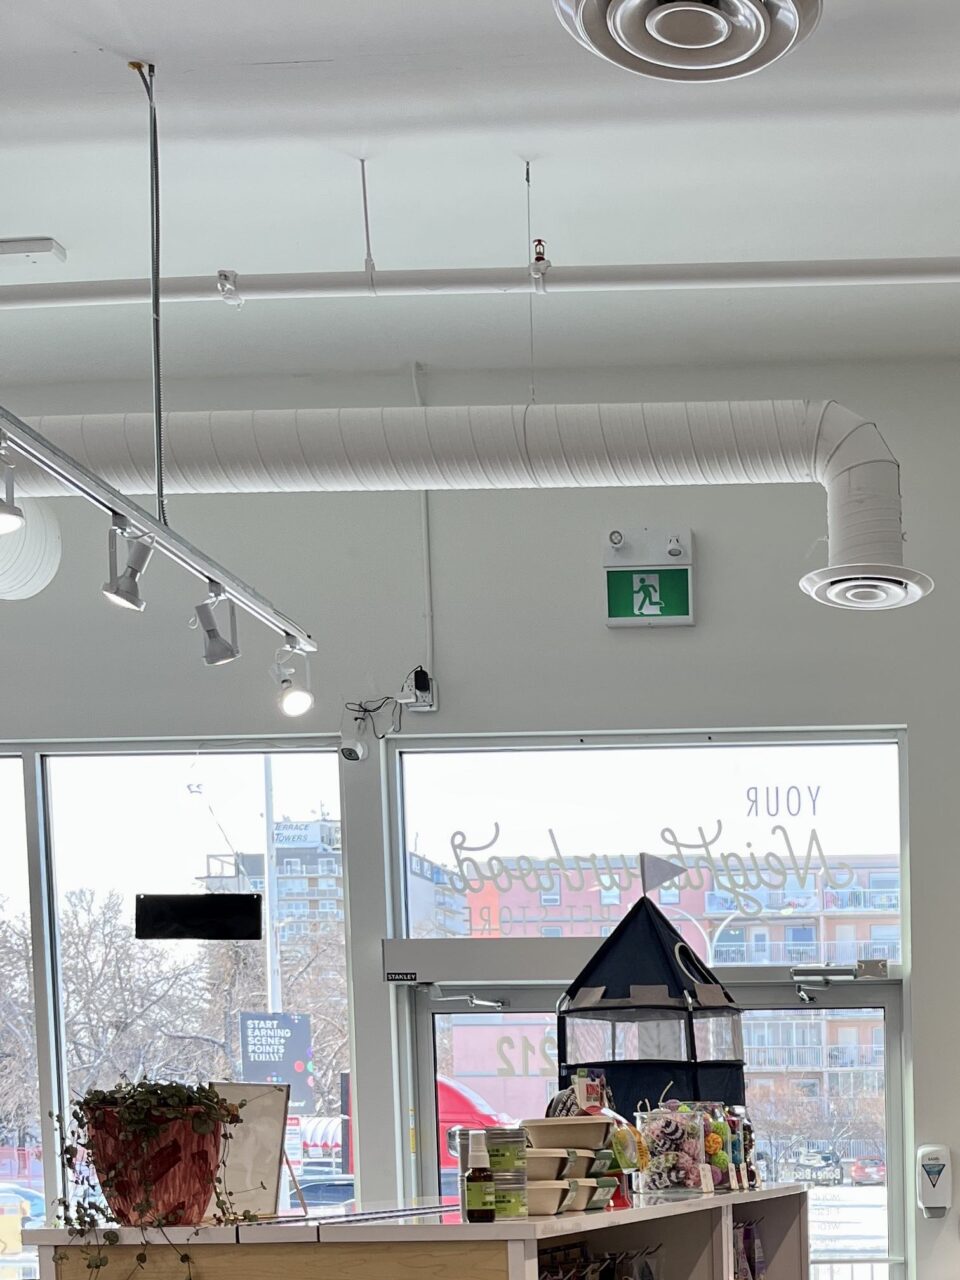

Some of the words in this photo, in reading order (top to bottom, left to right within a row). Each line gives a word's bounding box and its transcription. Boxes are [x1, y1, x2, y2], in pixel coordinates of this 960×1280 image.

[274, 823, 310, 831] TERRACE
[274, 832, 308, 842] TOWERS
[246, 1020, 279, 1028] START
[247, 1029, 292, 1037] EARNING
[247, 1037, 286, 1045] SCENE+
[247, 1045, 285, 1053] POINTS
[248, 1053, 284, 1061] TODAY!
